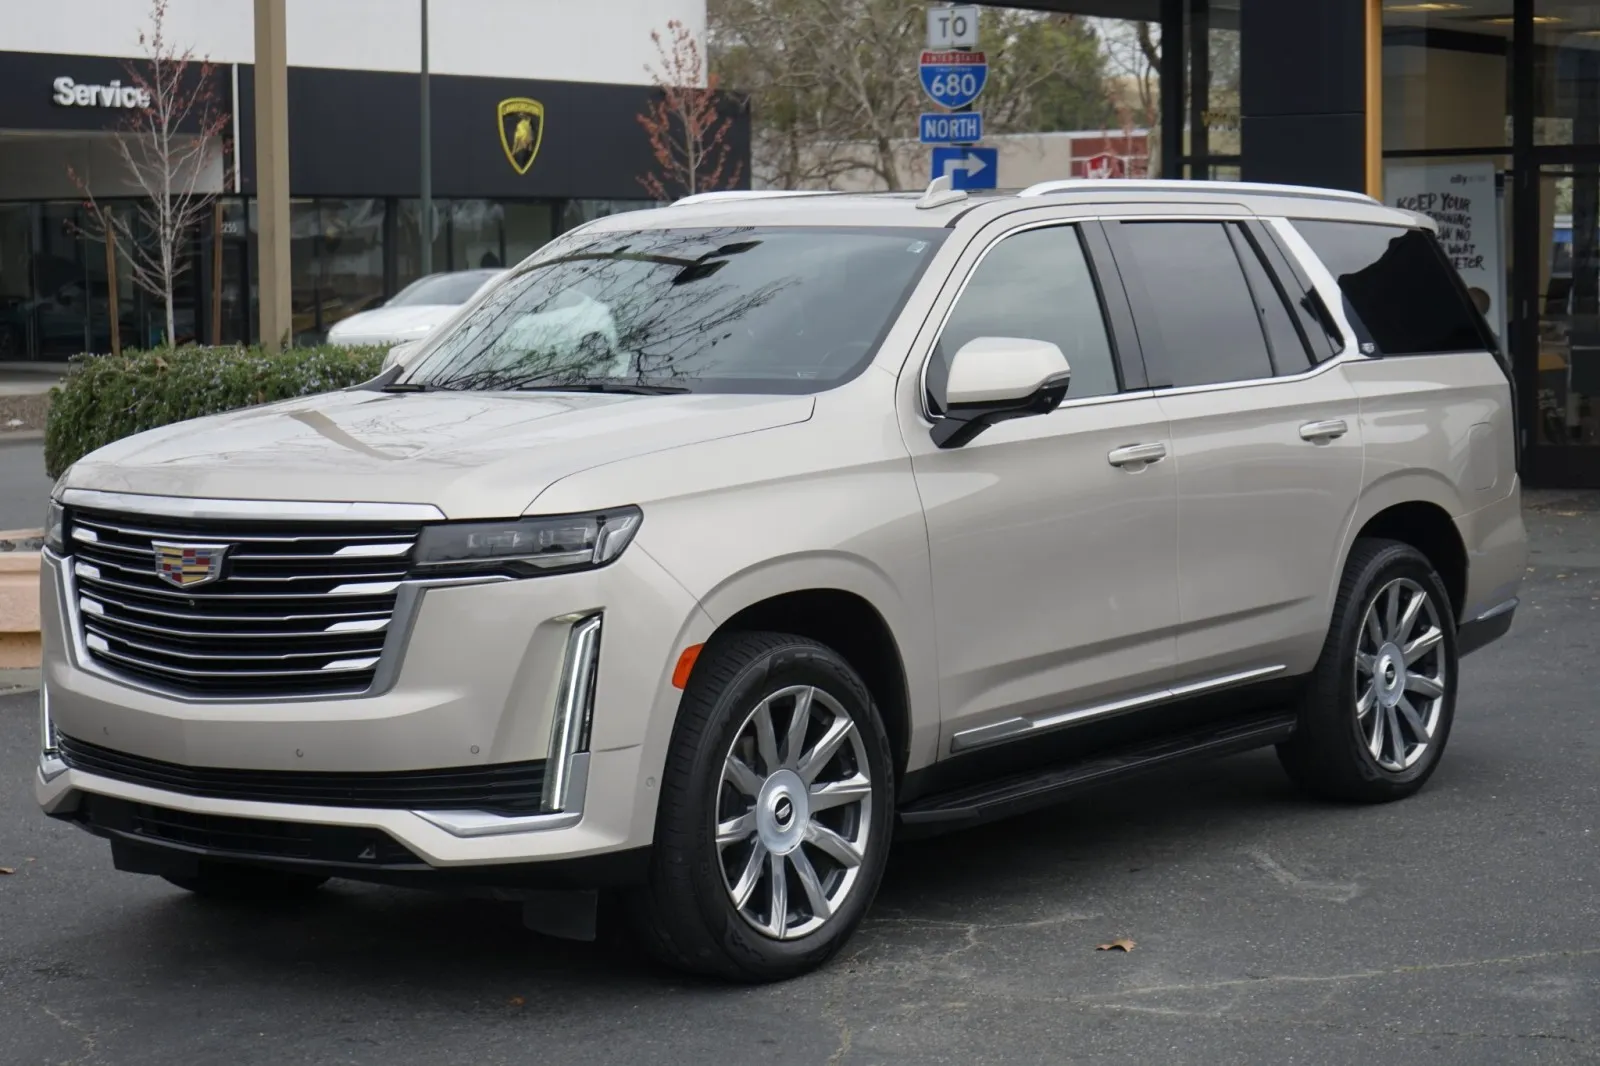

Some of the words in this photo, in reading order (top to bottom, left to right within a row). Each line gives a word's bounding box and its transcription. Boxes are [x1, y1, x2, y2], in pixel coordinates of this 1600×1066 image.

[938, 16, 967, 38] TO
[52, 76, 151, 108] Service
[931, 74, 975, 97] 680
[925, 118, 977, 138] NORTH
[1441, 193, 1471, 212] YOUR
[1457, 228, 1471, 241] NO
